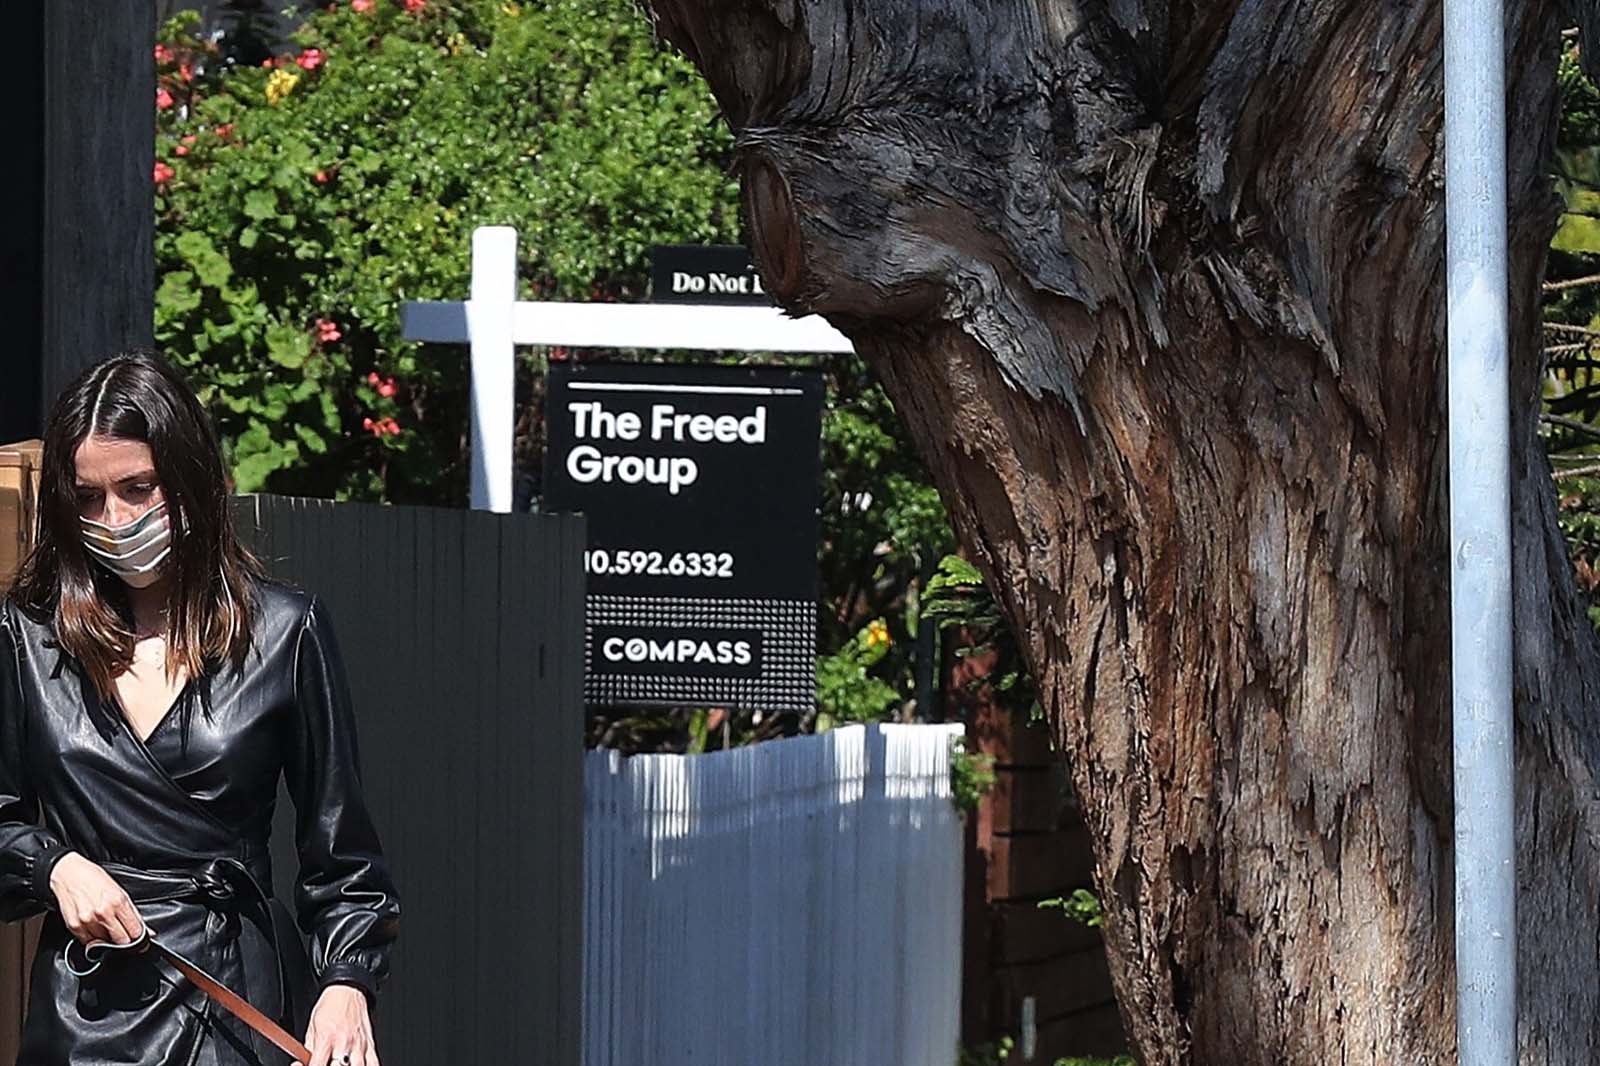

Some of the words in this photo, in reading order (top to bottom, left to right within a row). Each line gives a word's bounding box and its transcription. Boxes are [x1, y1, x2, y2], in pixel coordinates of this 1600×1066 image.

[672, 271, 706, 293] Do
[708, 272, 749, 294] Not
[568, 402, 642, 440] The
[651, 404, 767, 443] Freed
[567, 445, 698, 494] Group
[603, 637, 752, 664] COMPASS
